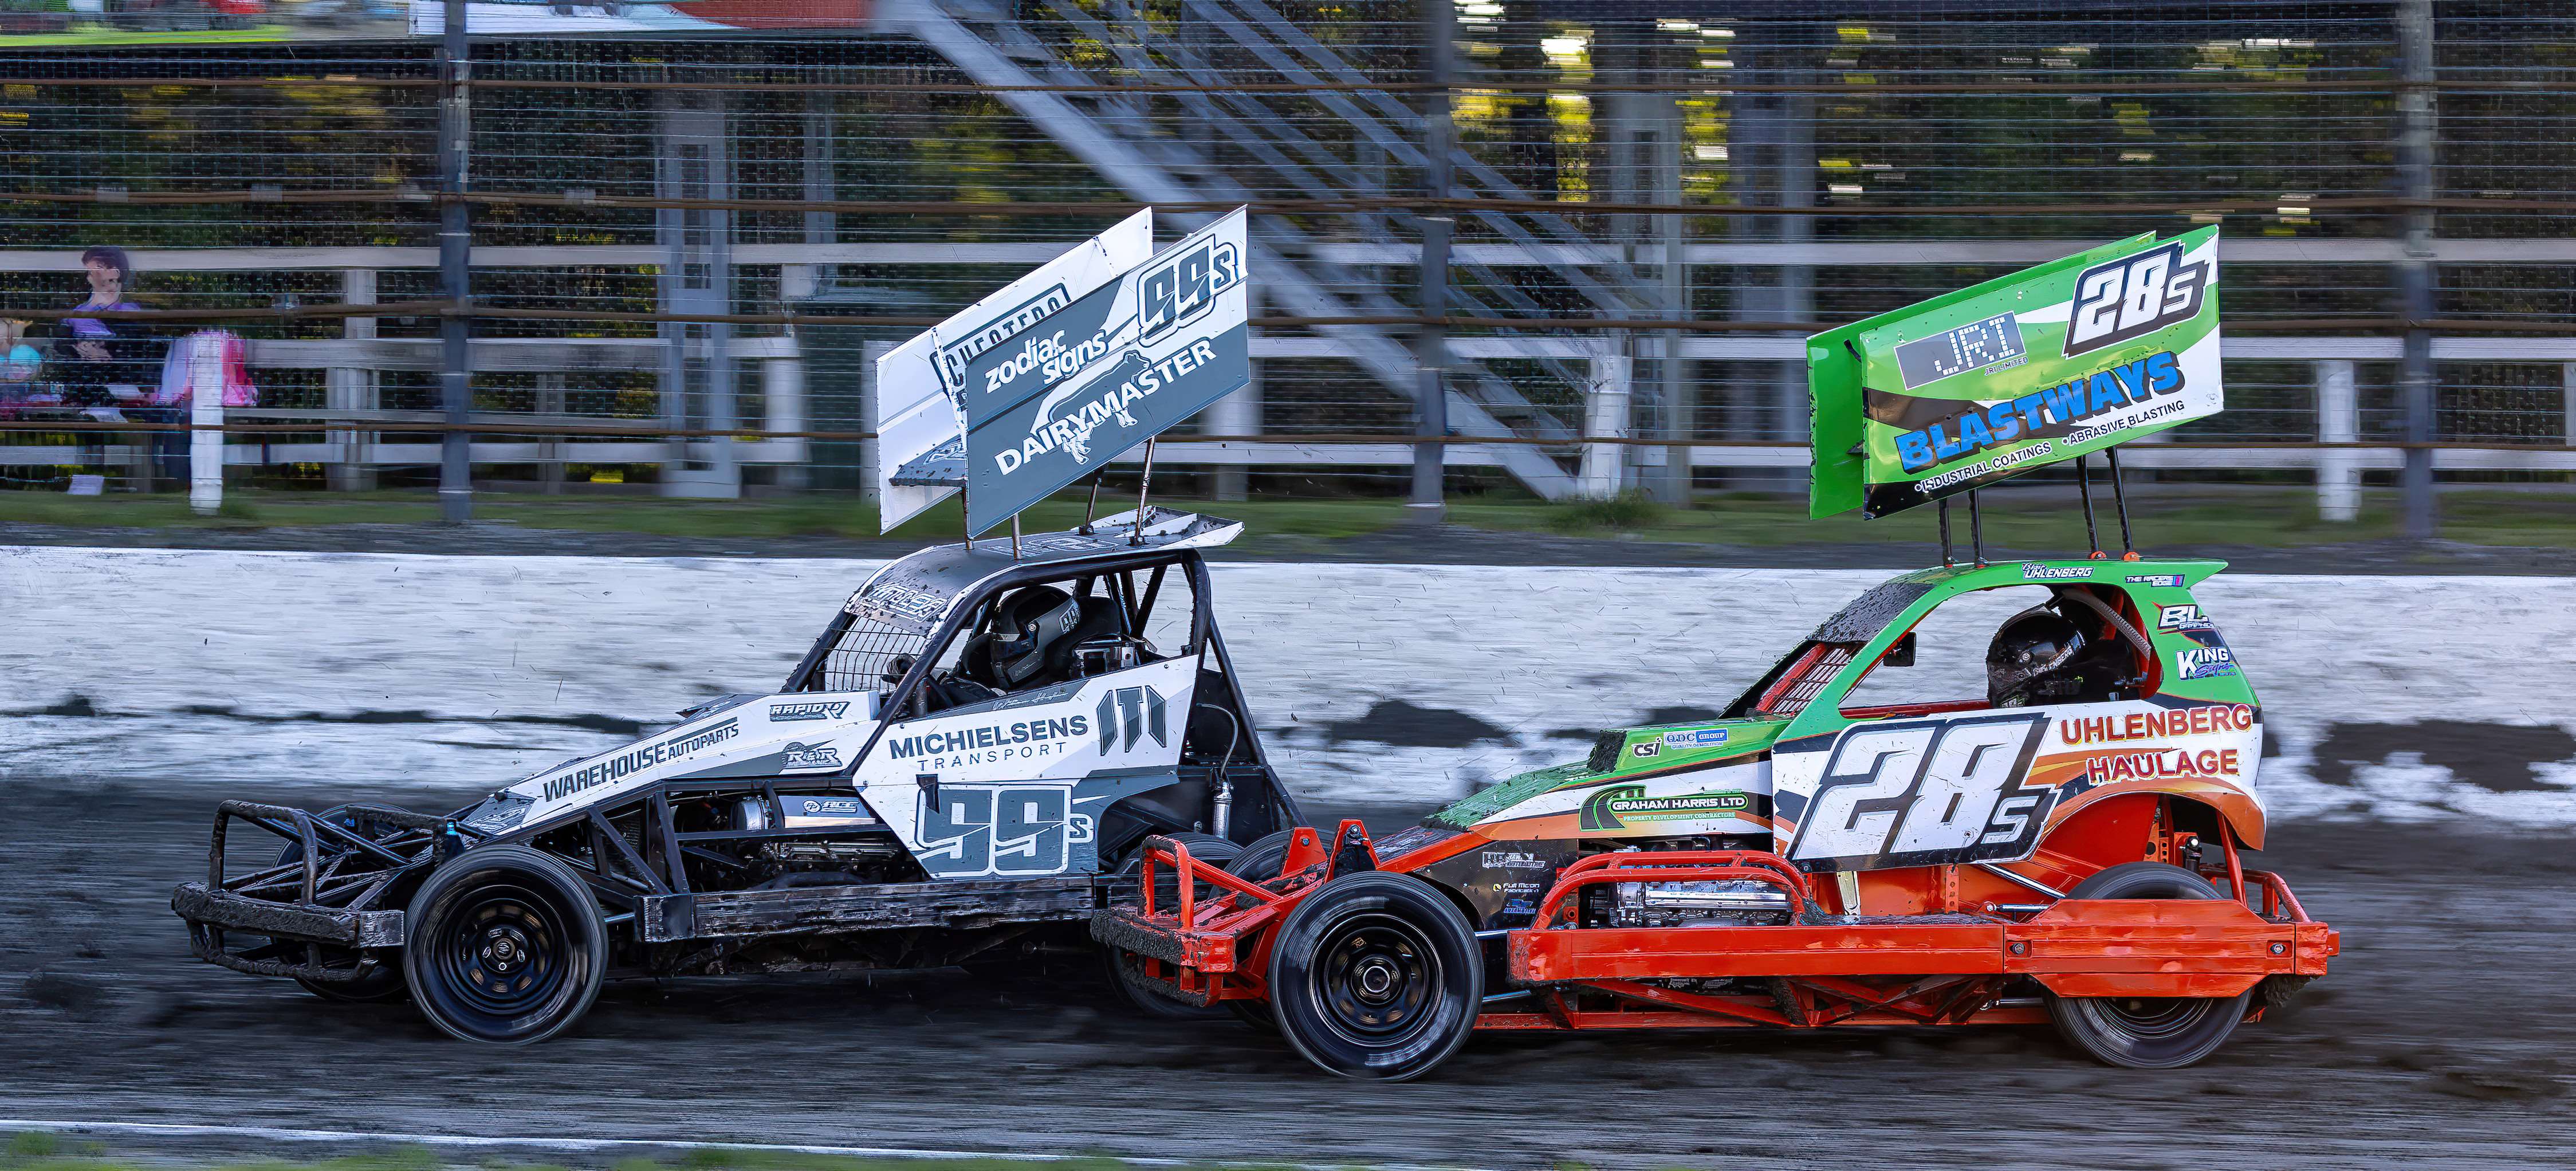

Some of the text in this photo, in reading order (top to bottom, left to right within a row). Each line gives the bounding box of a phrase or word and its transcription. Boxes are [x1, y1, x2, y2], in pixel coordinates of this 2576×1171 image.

[985, 329, 1066, 394] zodiac
[1041, 329, 1108, 385] signs
[1934, 316, 2016, 376] JRI
[994, 339, 1218, 477] DAIRYMASTER
[1895, 352, 2182, 474] BLASTWAYS
[2070, 400, 2185, 445] ABRASIVE BLASTING
[1992, 442, 2052, 469] COATINGS
[2024, 567, 2094, 578] UHLENBERG
[2176, 647, 2230, 679] KING
[889, 714, 1088, 760] MICHIELSENS
[2061, 705, 2253, 745] UHLENBERG
[543, 724, 739, 803] WAREHOUSE AUTOPARTS
[917, 742, 1066, 772] TRANSPORT
[2088, 748, 2239, 785] HAULAGE
[1612, 796, 1746, 811] GRAHAM HARRIS LTD
